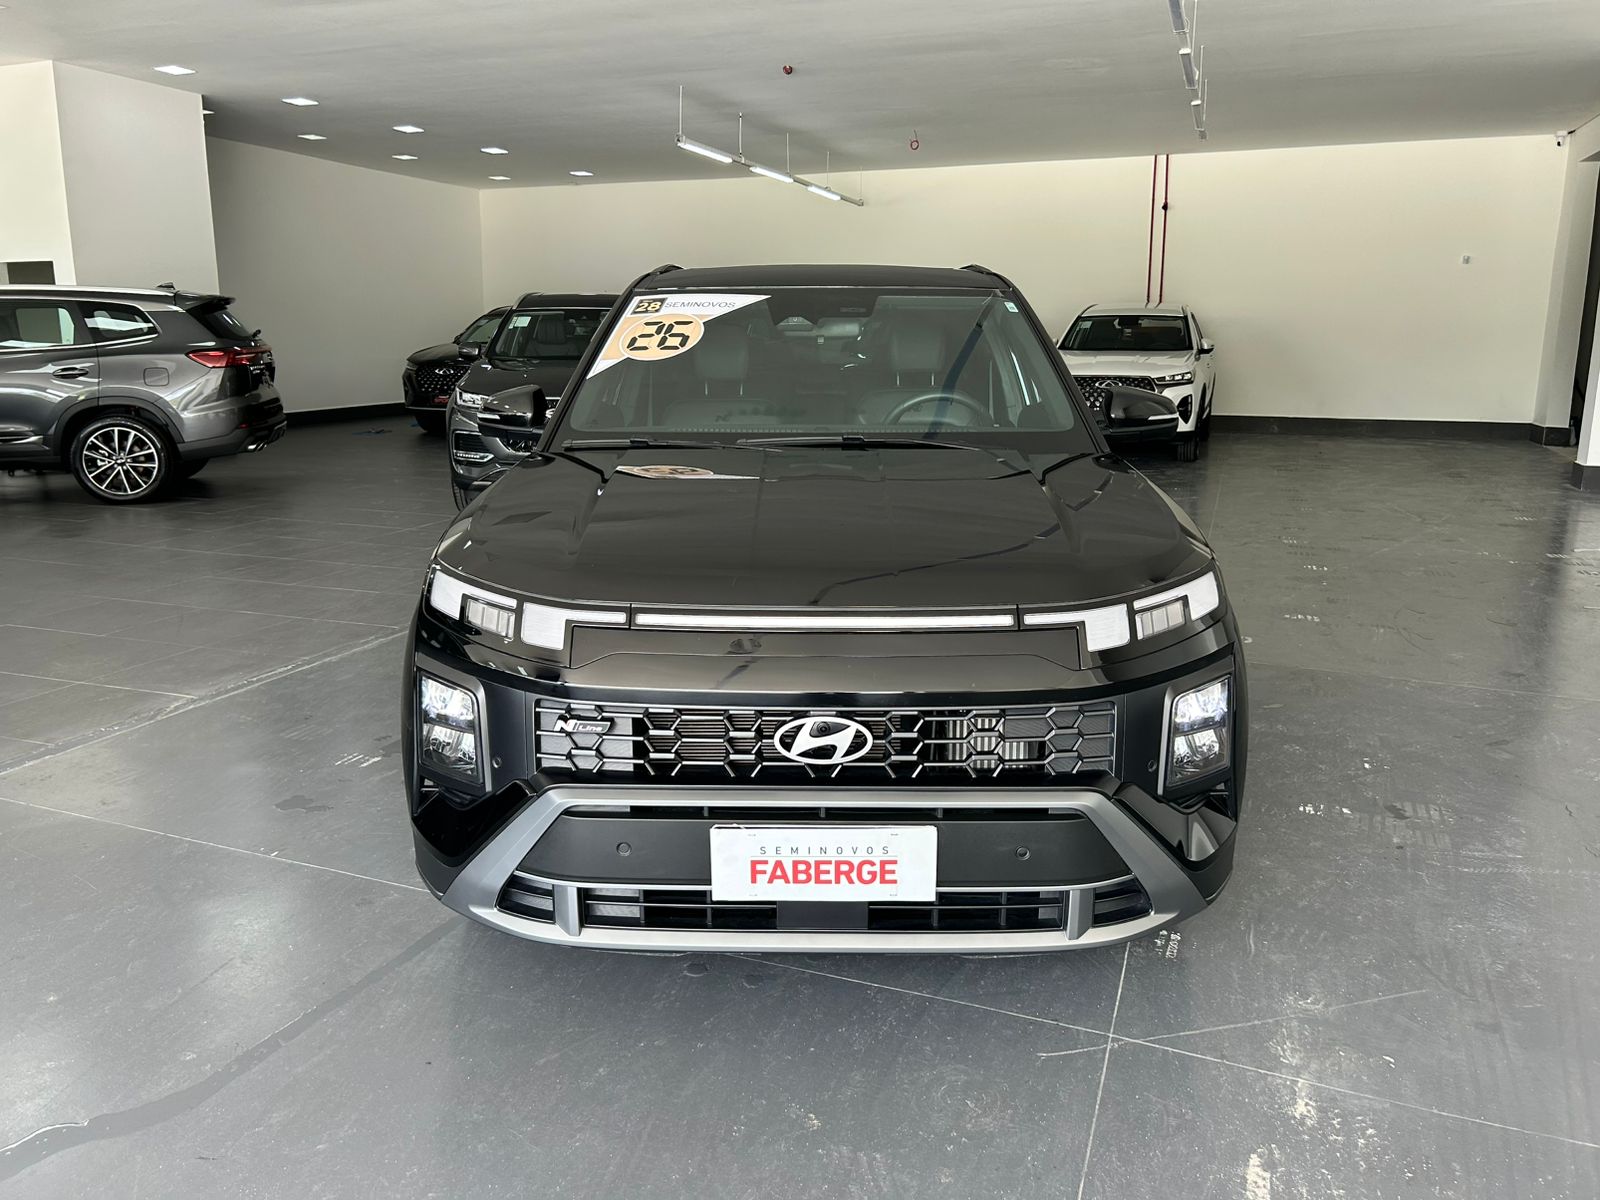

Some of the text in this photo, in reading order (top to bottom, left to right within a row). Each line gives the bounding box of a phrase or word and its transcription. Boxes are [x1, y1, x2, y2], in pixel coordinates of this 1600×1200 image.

[634, 302, 662, 312] 28
[627, 320, 694, 351] 26
[554, 719, 577, 732] N
[759, 846, 889, 855] SEMINOVOS
[750, 859, 898, 885] FABERGE
